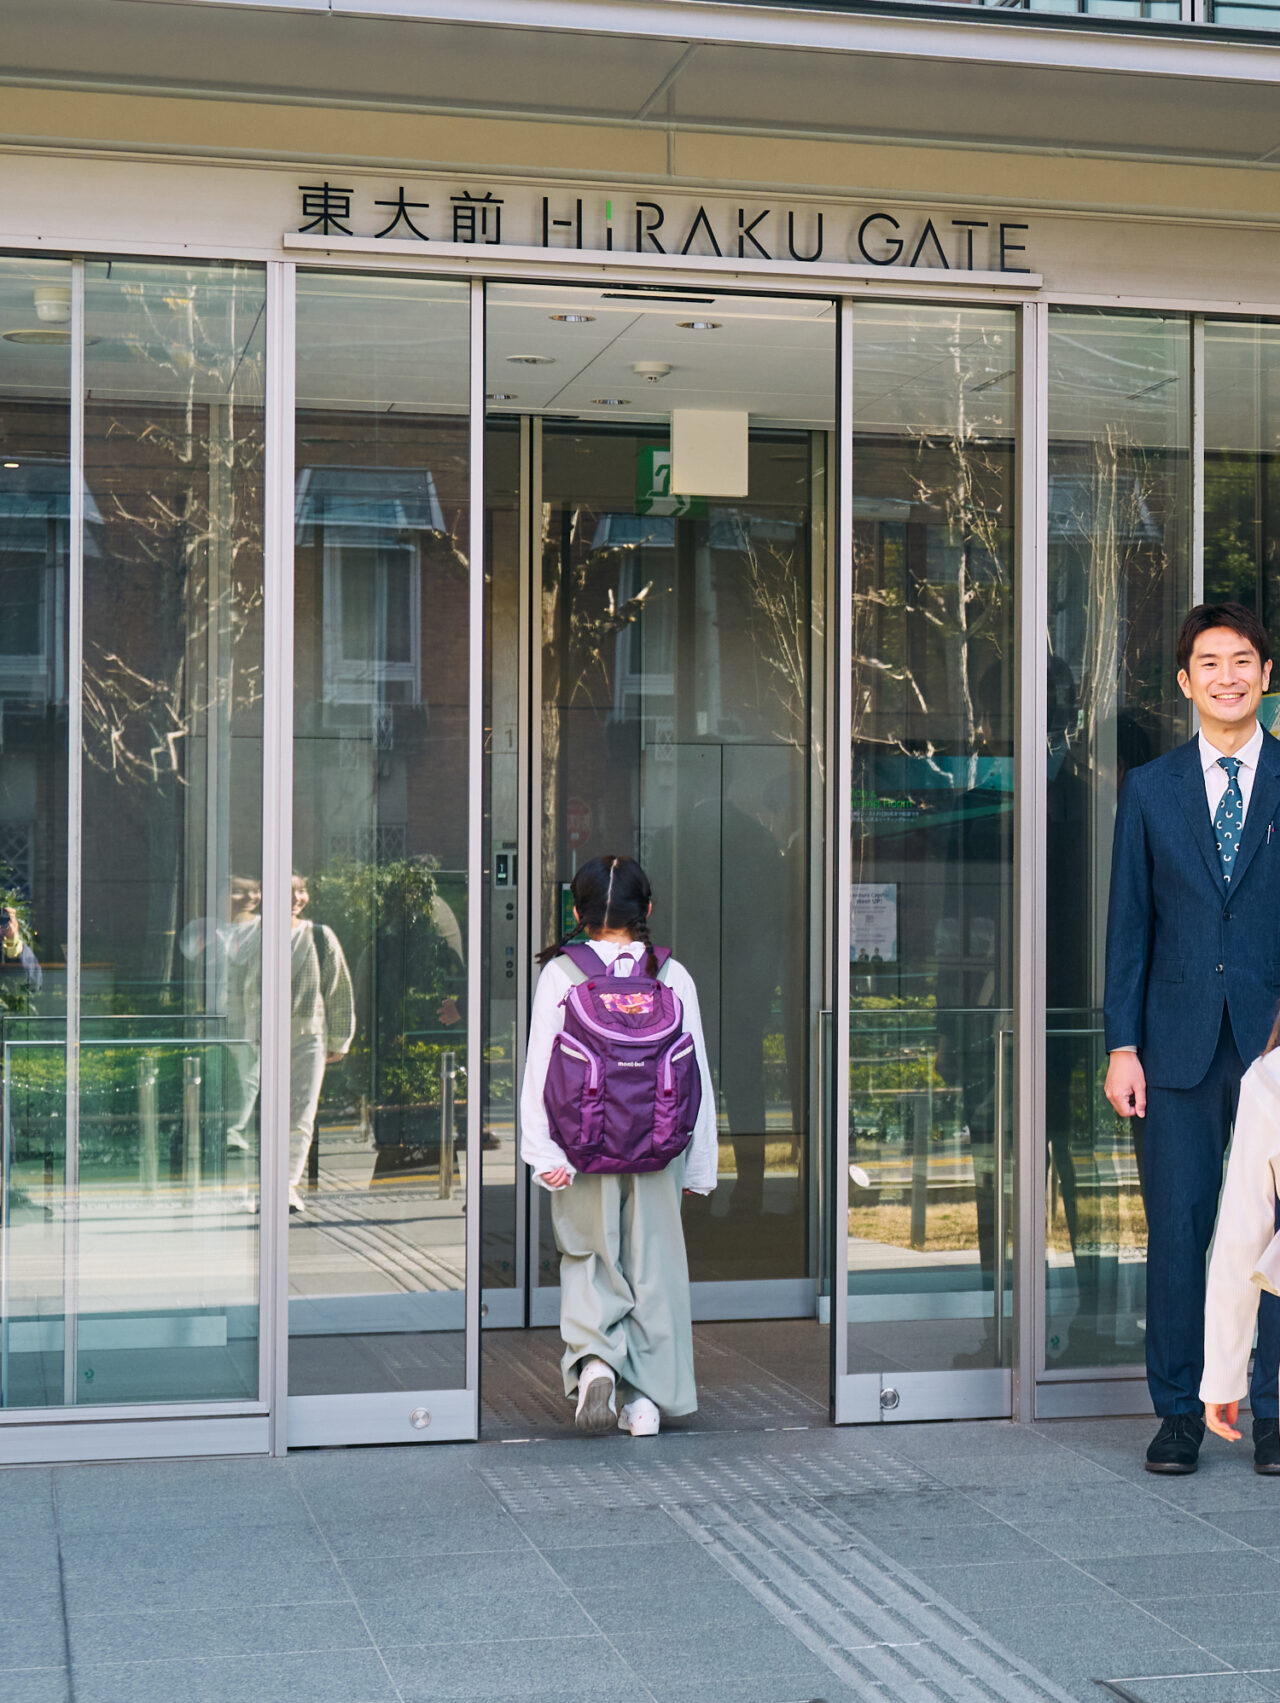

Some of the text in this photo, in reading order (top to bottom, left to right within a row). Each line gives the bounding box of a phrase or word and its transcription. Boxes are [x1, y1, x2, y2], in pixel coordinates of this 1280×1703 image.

[297, 181, 505, 246] 東大前
[857, 212, 1032, 274] GATE
